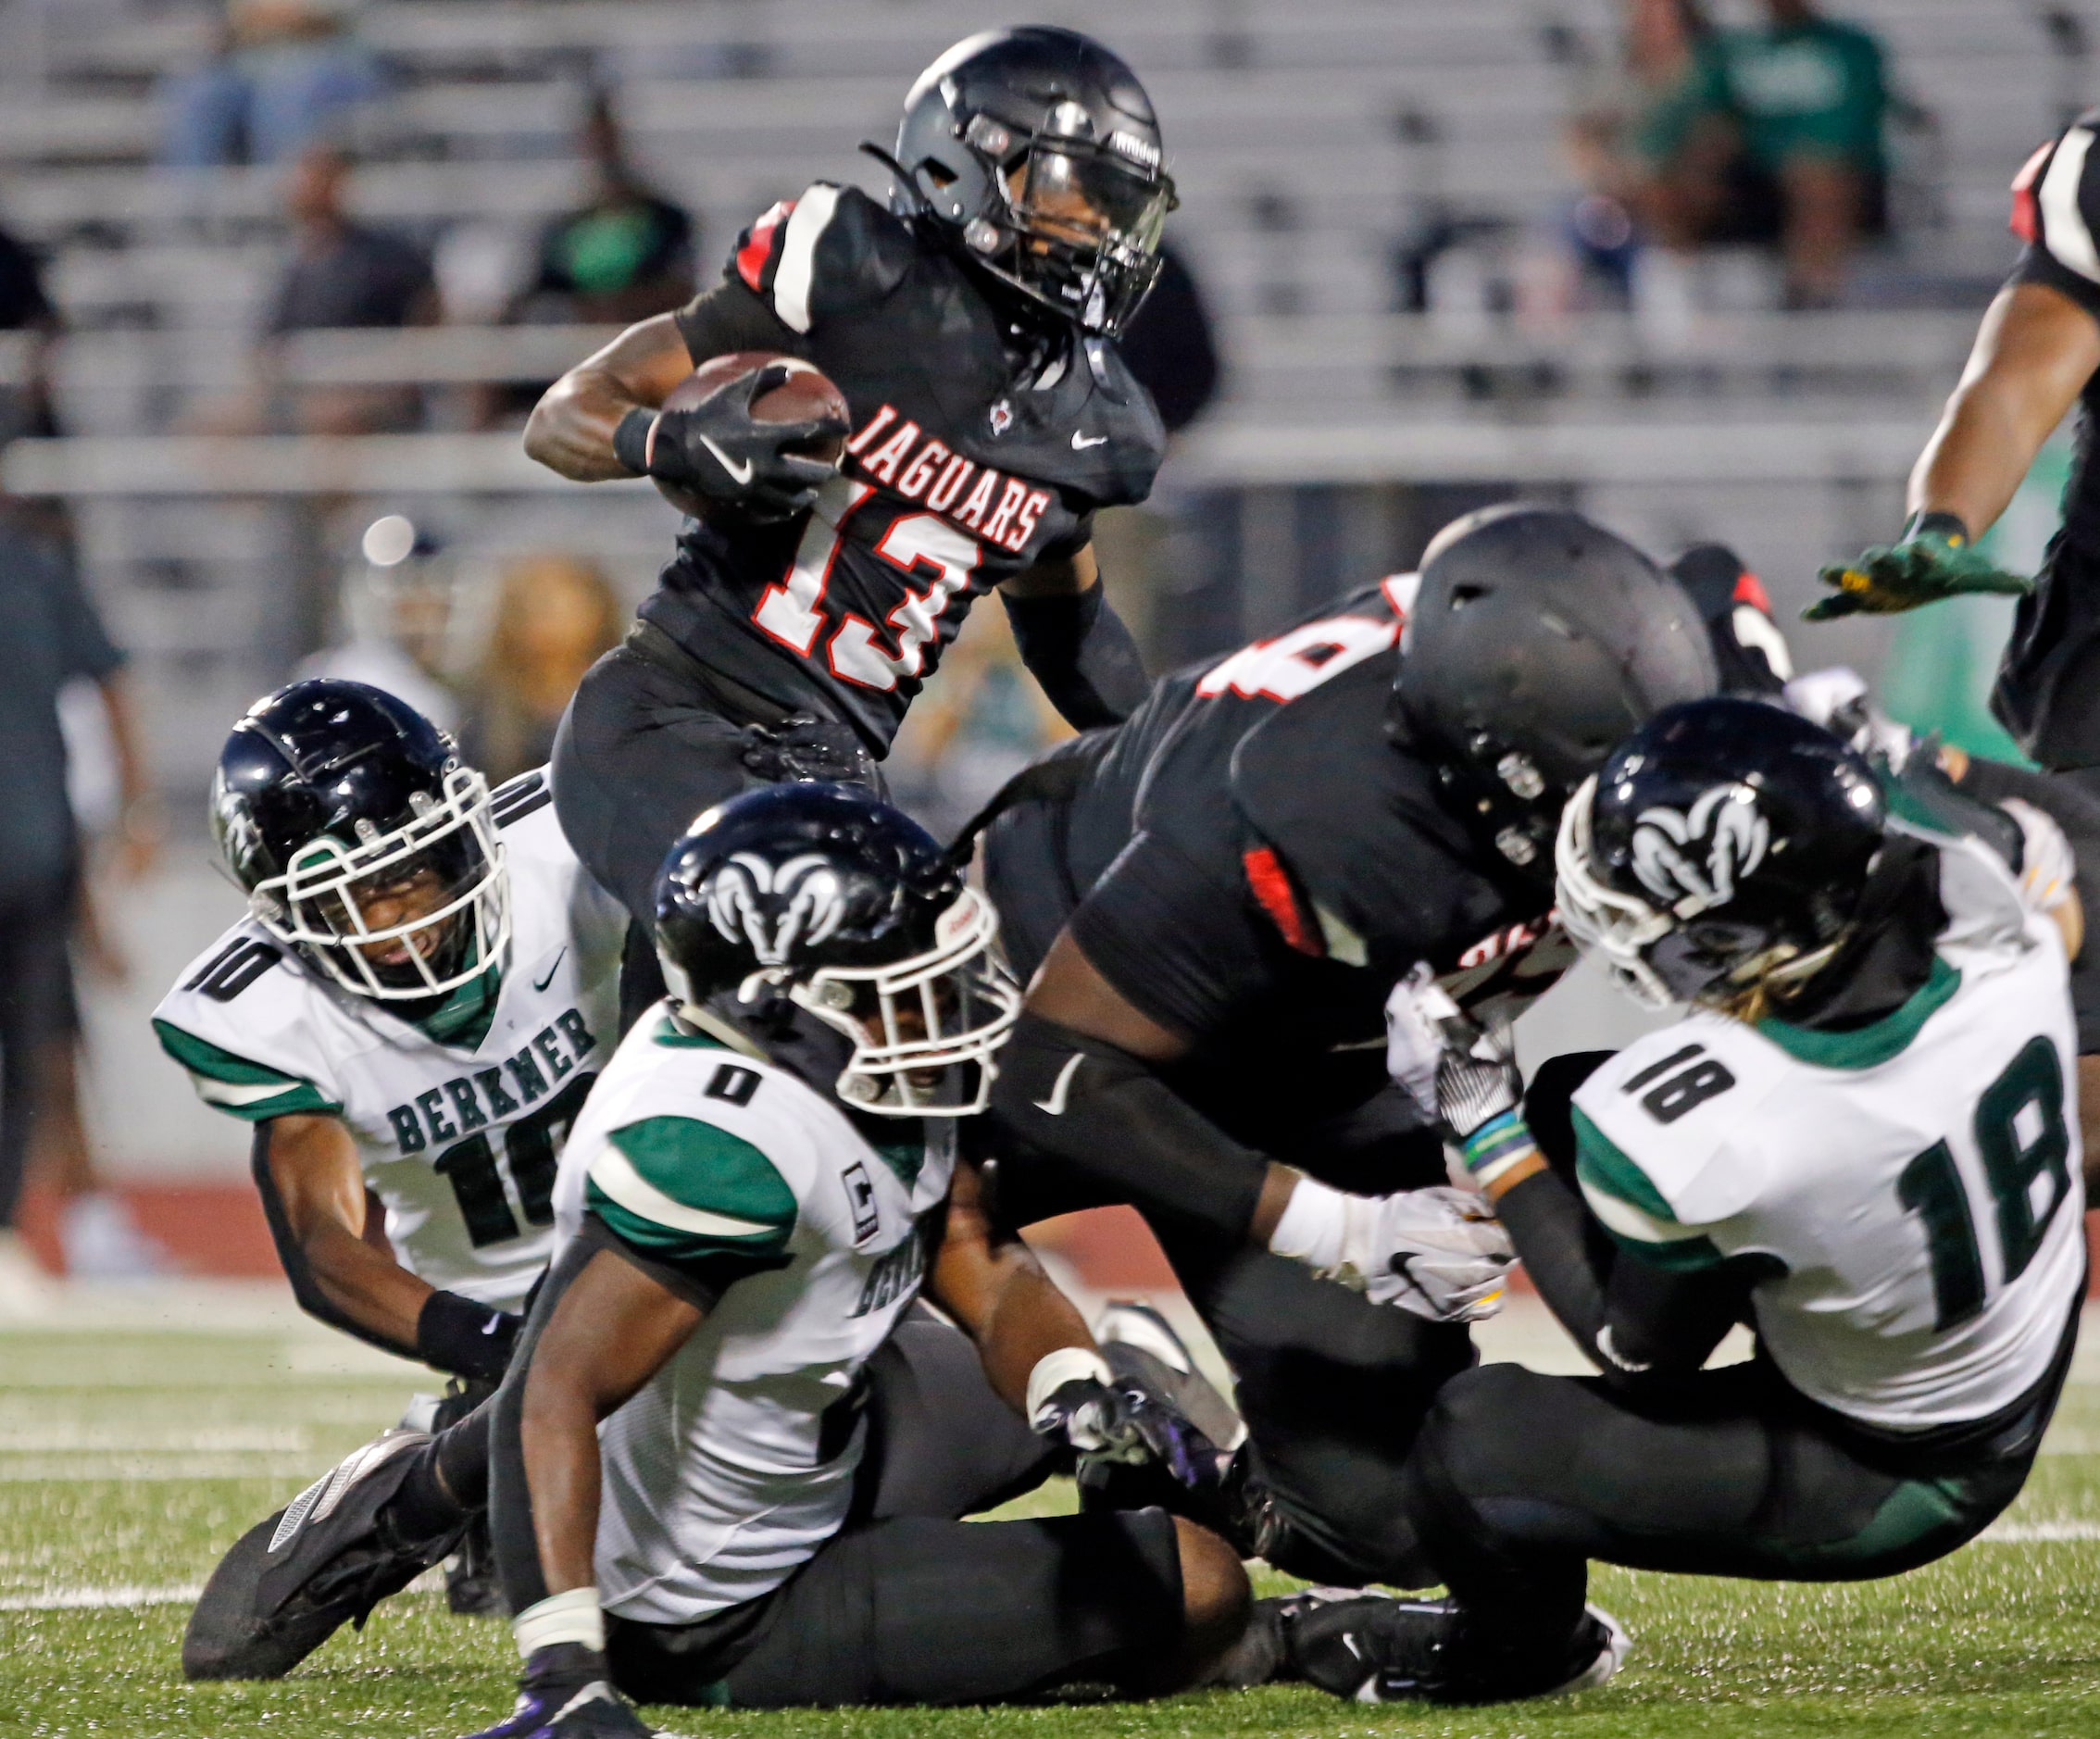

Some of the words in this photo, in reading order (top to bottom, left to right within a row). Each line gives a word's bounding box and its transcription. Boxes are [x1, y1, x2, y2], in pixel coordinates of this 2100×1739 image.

[846, 404, 1050, 552] JAGUARS
[751, 478, 982, 692] 13
[181, 936, 282, 1003] 10
[387, 1008, 597, 1155] BERKNER
[1619, 1043, 1736, 1124] 18
[1895, 1034, 2072, 1334] 18
